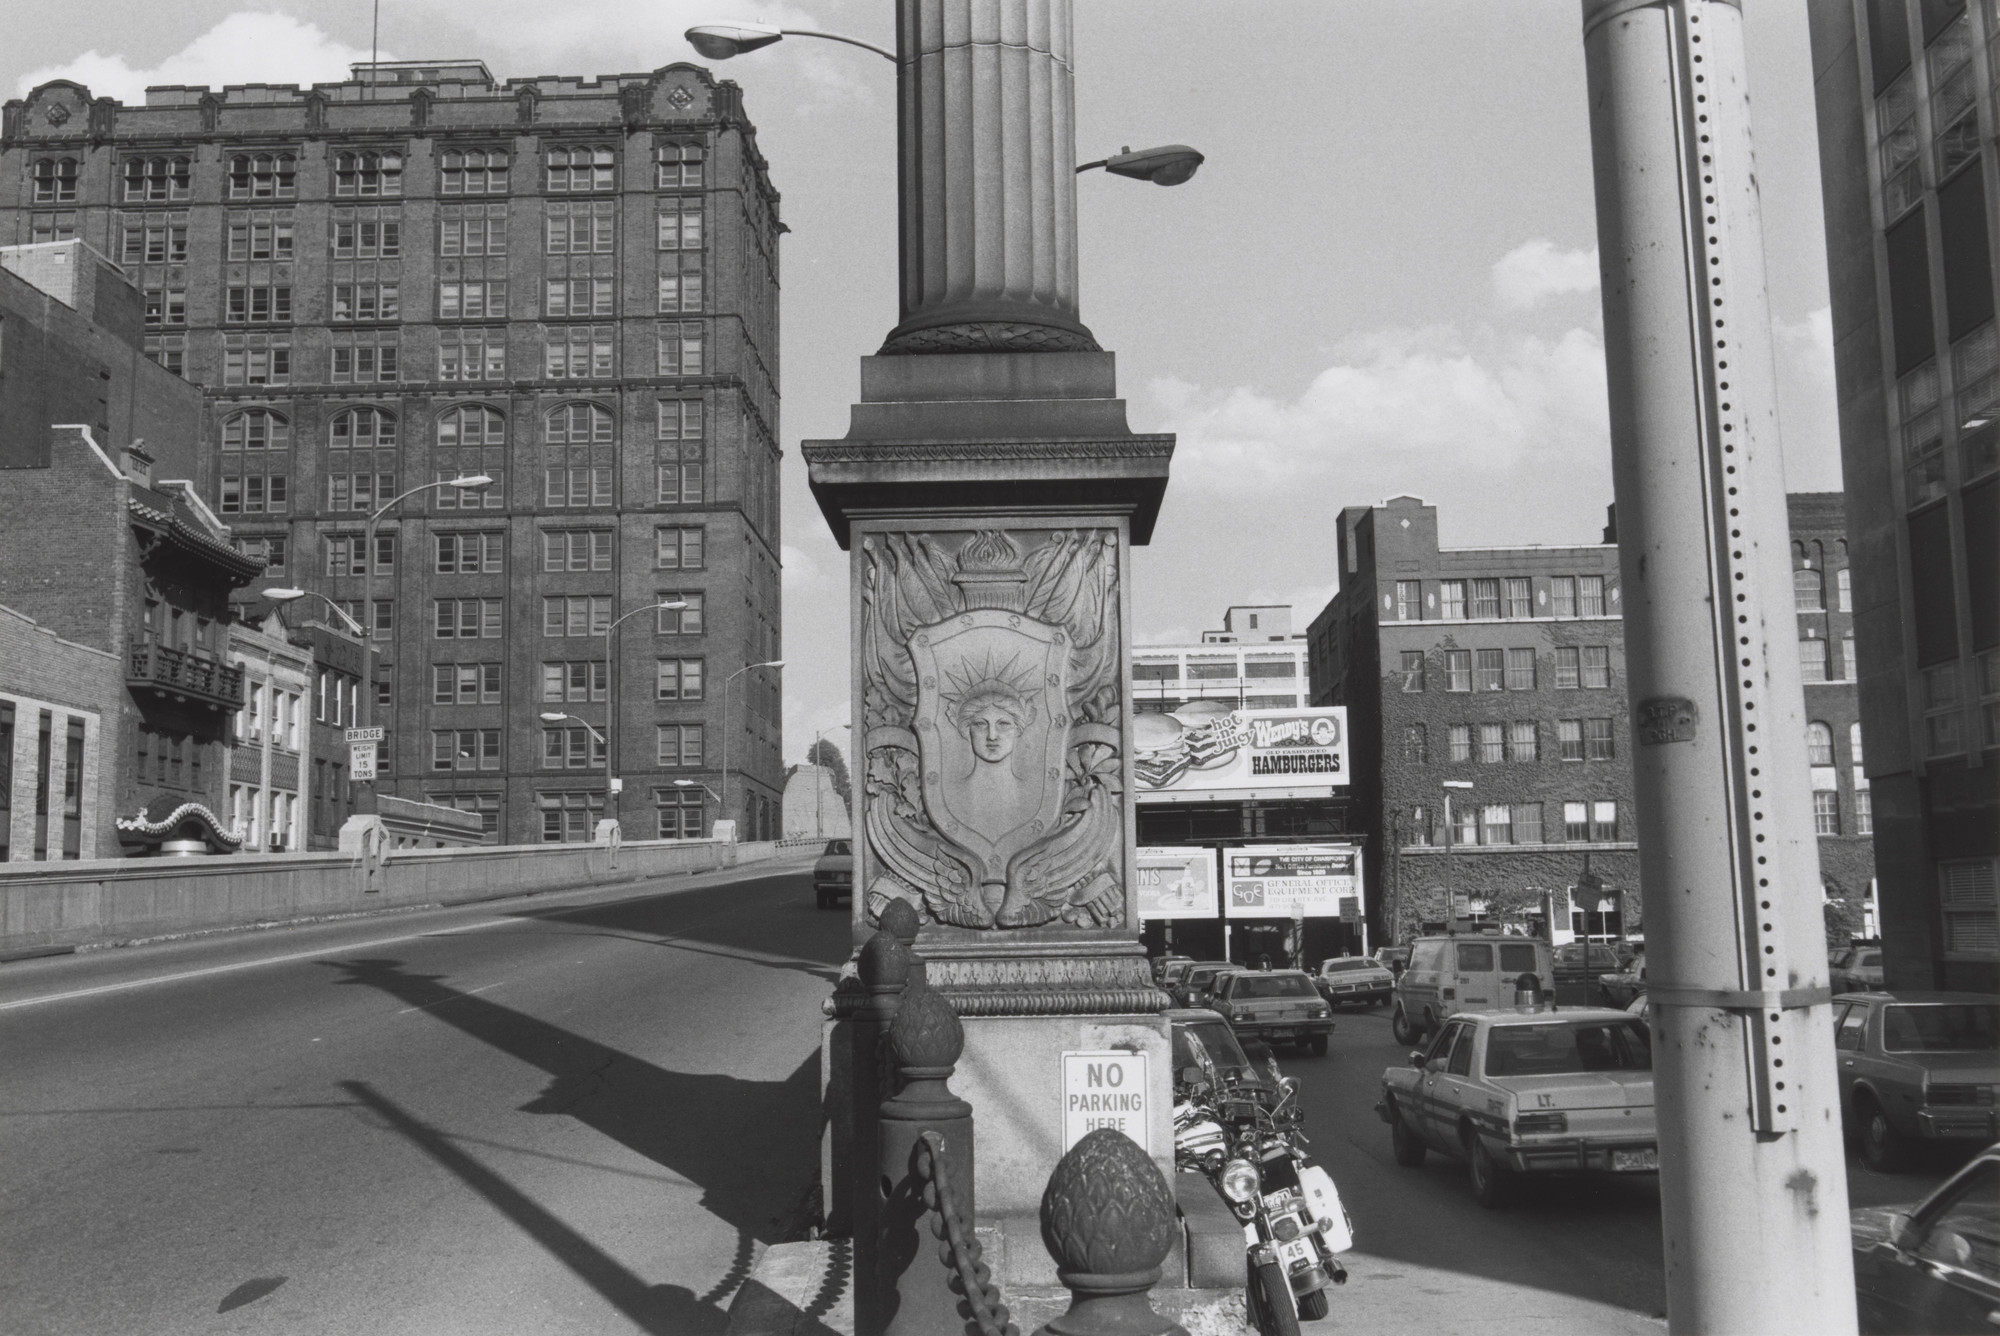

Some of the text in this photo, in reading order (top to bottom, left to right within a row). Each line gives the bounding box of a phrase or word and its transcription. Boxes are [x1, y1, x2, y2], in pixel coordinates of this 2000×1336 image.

[1211, 713, 1241, 731] hot
[347, 729, 381, 740] BRIDGE
[1213, 729, 1254, 753] juicy
[359, 761, 368, 769] 15
[1252, 753, 1340, 775] HAMBURGERS
[354, 769, 373, 778] TONS
[1316, 879, 1350, 887] OFFICE
[1268, 887, 1326, 895] EQUIPMENT
[1088, 1063, 1123, 1088] NO
[1069, 1093, 1142, 1112] PARKING
[1086, 1118, 1126, 1131] HERE
[1287, 1243, 1304, 1258] 45
